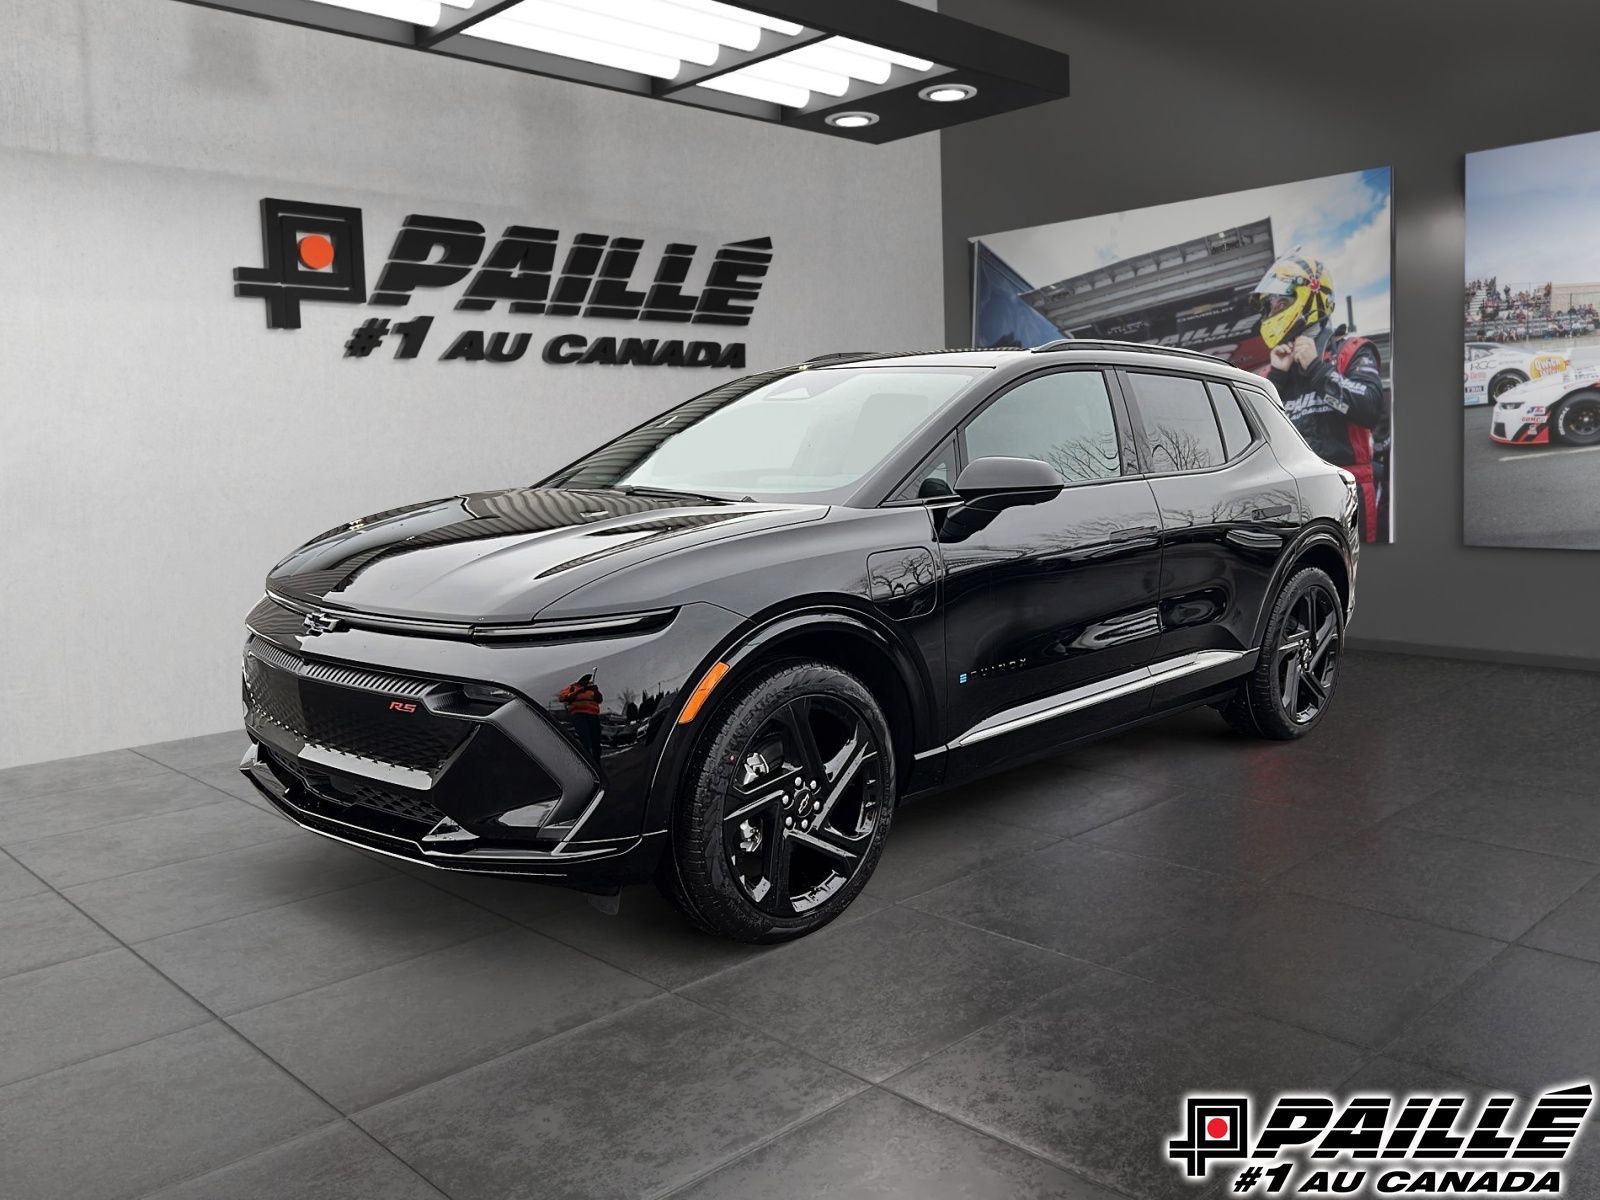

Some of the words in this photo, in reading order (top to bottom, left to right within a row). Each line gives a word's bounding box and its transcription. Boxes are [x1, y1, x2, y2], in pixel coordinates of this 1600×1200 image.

[343, 315, 434, 361] #1
[438, 330, 533, 364] AU
[542, 333, 747, 369] CANADA
[389, 701, 417, 713] RS
